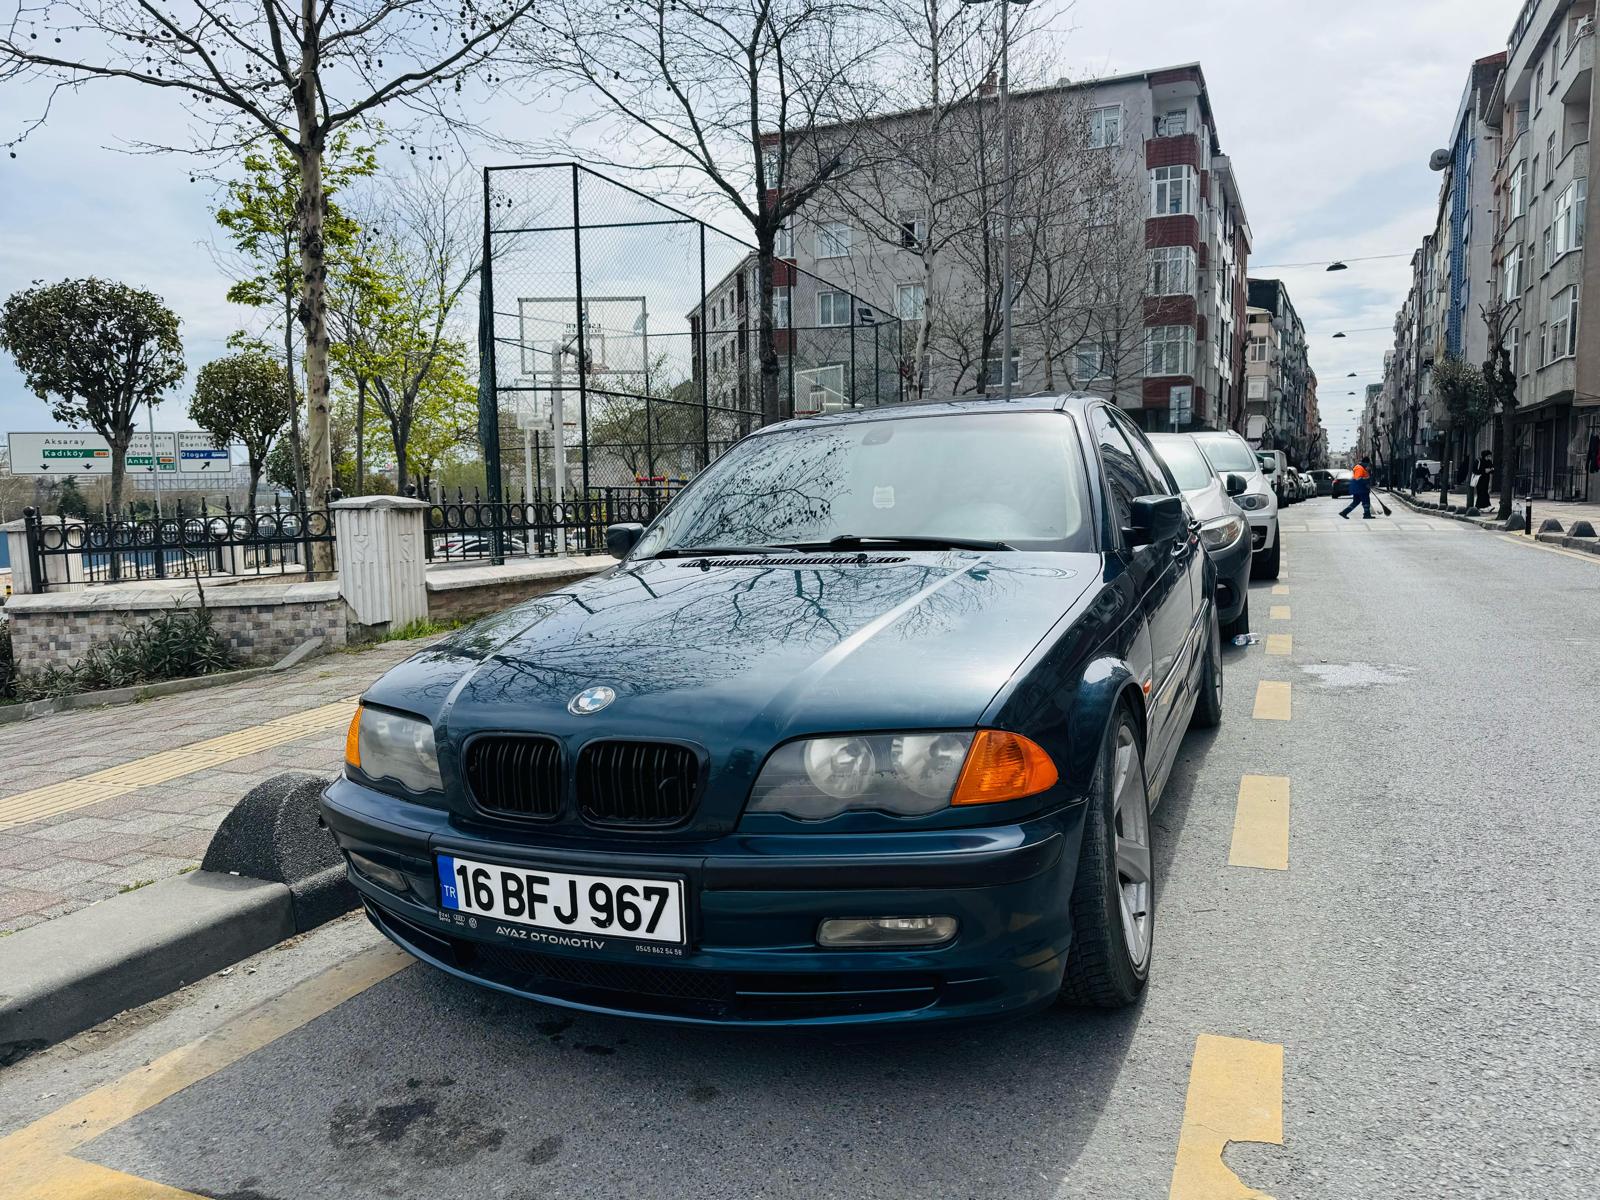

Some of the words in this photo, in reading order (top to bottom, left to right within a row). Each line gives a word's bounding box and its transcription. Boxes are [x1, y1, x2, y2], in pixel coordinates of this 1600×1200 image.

[44, 438, 86, 446] Aksaray
[44, 450, 84, 458] Kadıköy
[443, 884, 457, 899] TR
[456, 864, 494, 912] 16
[500, 871, 578, 925] BFJ
[588, 882, 669, 934] 967
[496, 926, 527, 938] AYAZ
[530, 932, 605, 950] OTOMOTİV
